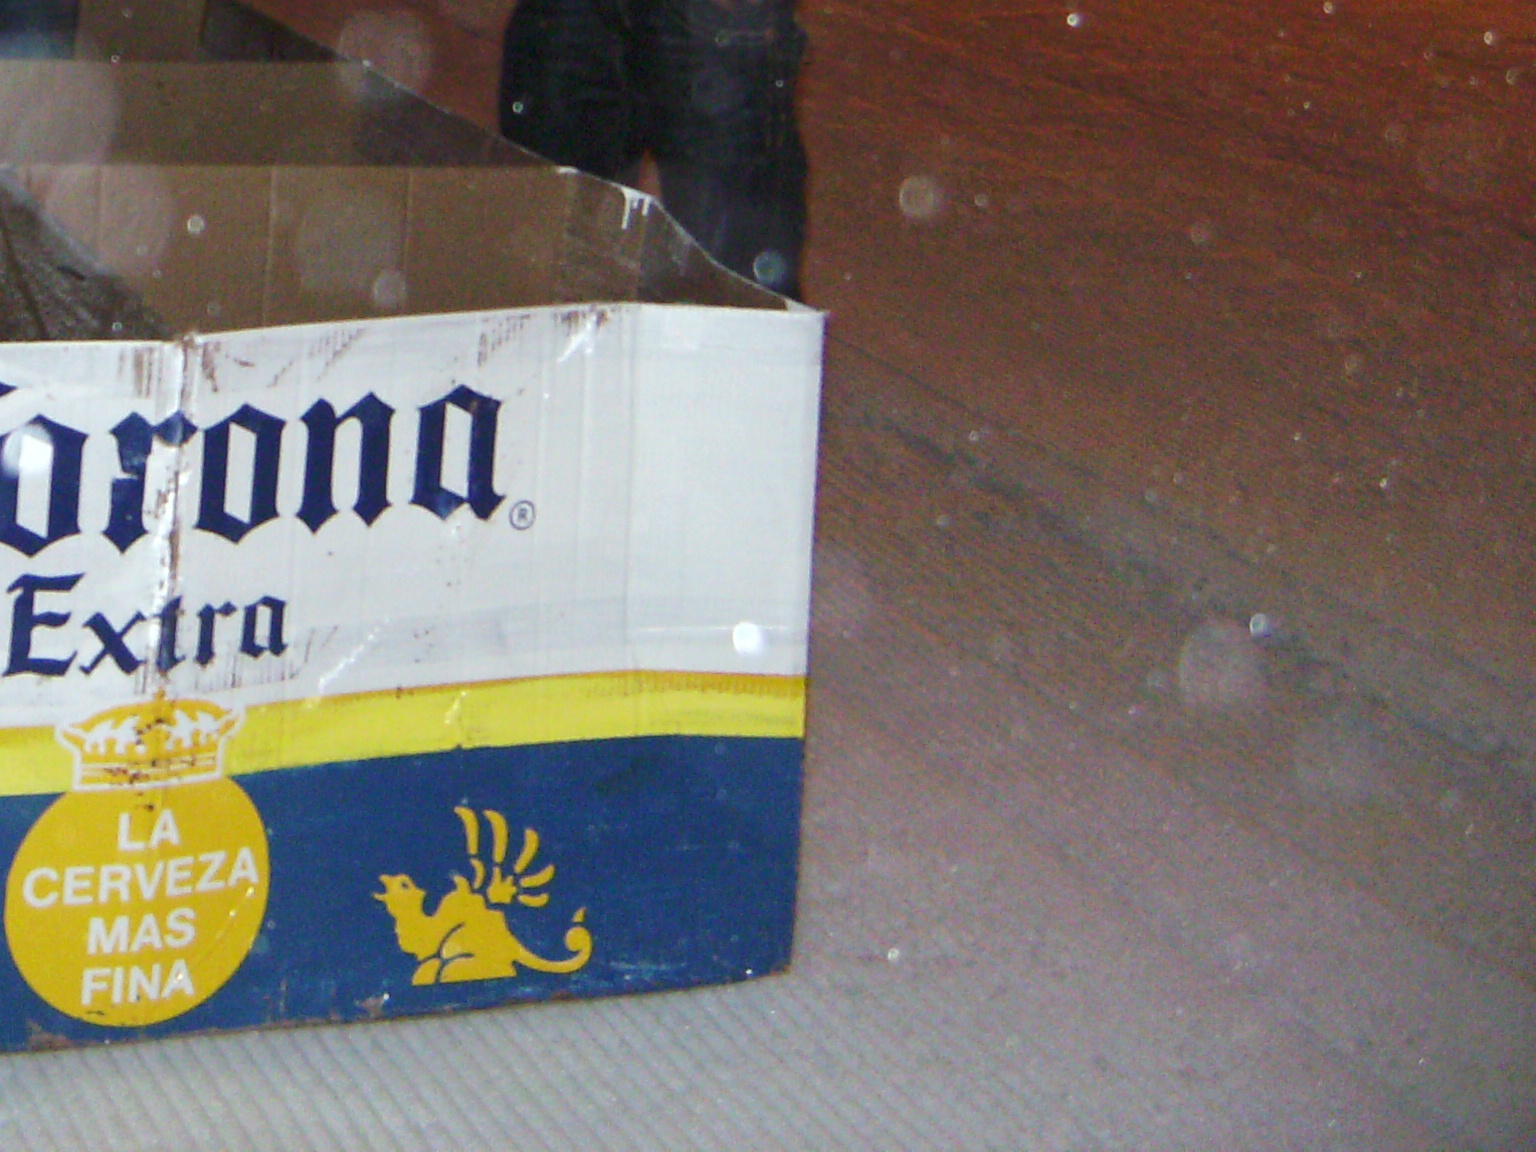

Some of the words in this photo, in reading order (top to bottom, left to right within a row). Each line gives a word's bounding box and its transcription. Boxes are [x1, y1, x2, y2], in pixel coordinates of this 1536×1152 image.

[0, 572, 289, 679] Extra
[117, 809, 181, 851] LA
[22, 847, 259, 908] CERVEZA
[87, 907, 196, 955] MAS
[81, 959, 195, 1006] FINA
